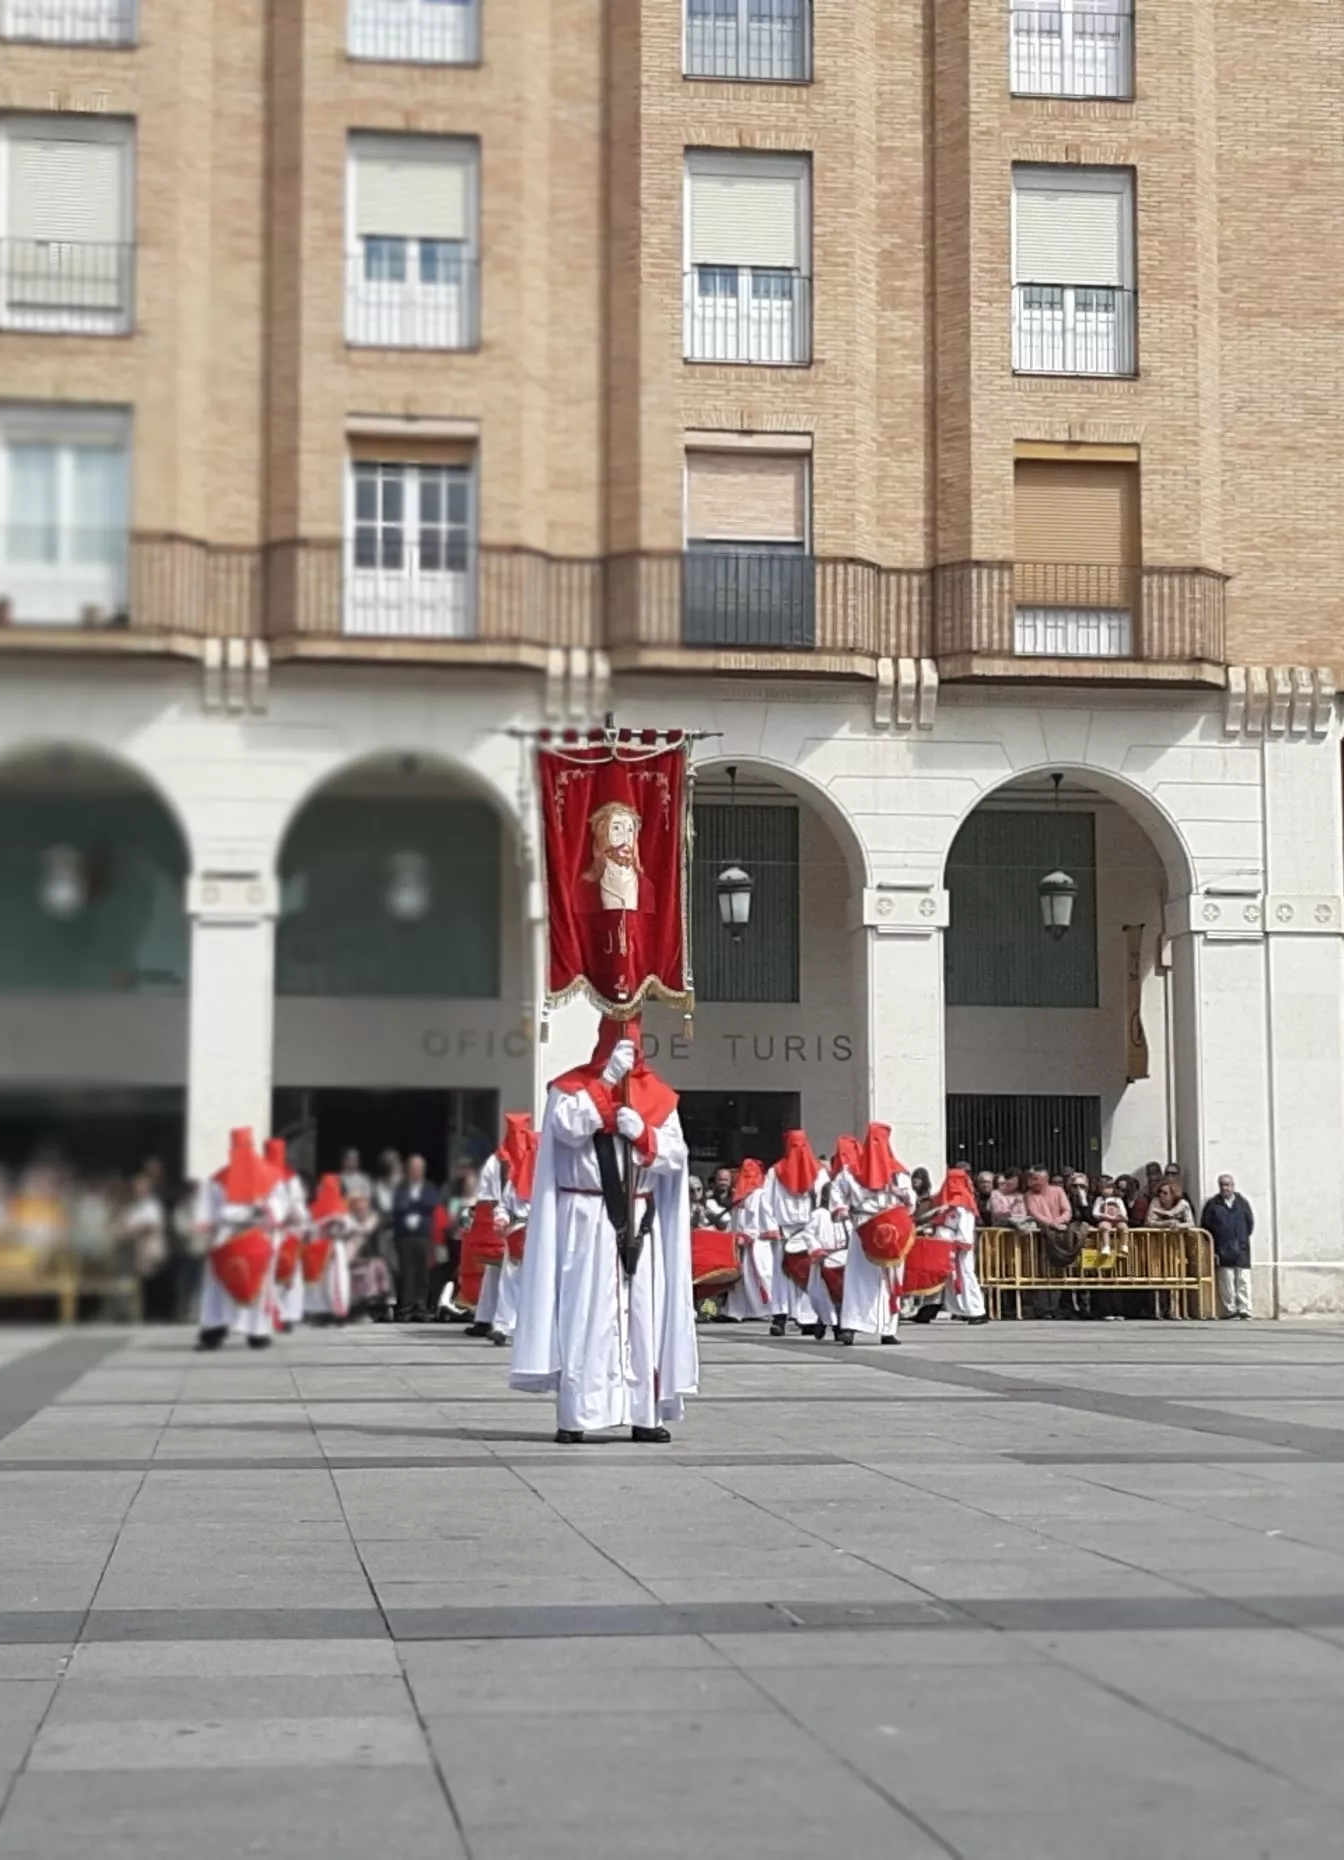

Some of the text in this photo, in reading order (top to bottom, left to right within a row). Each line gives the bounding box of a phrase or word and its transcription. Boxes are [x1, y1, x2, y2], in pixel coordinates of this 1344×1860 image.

[421, 1028, 853, 1063] OFIC DE TURIS
